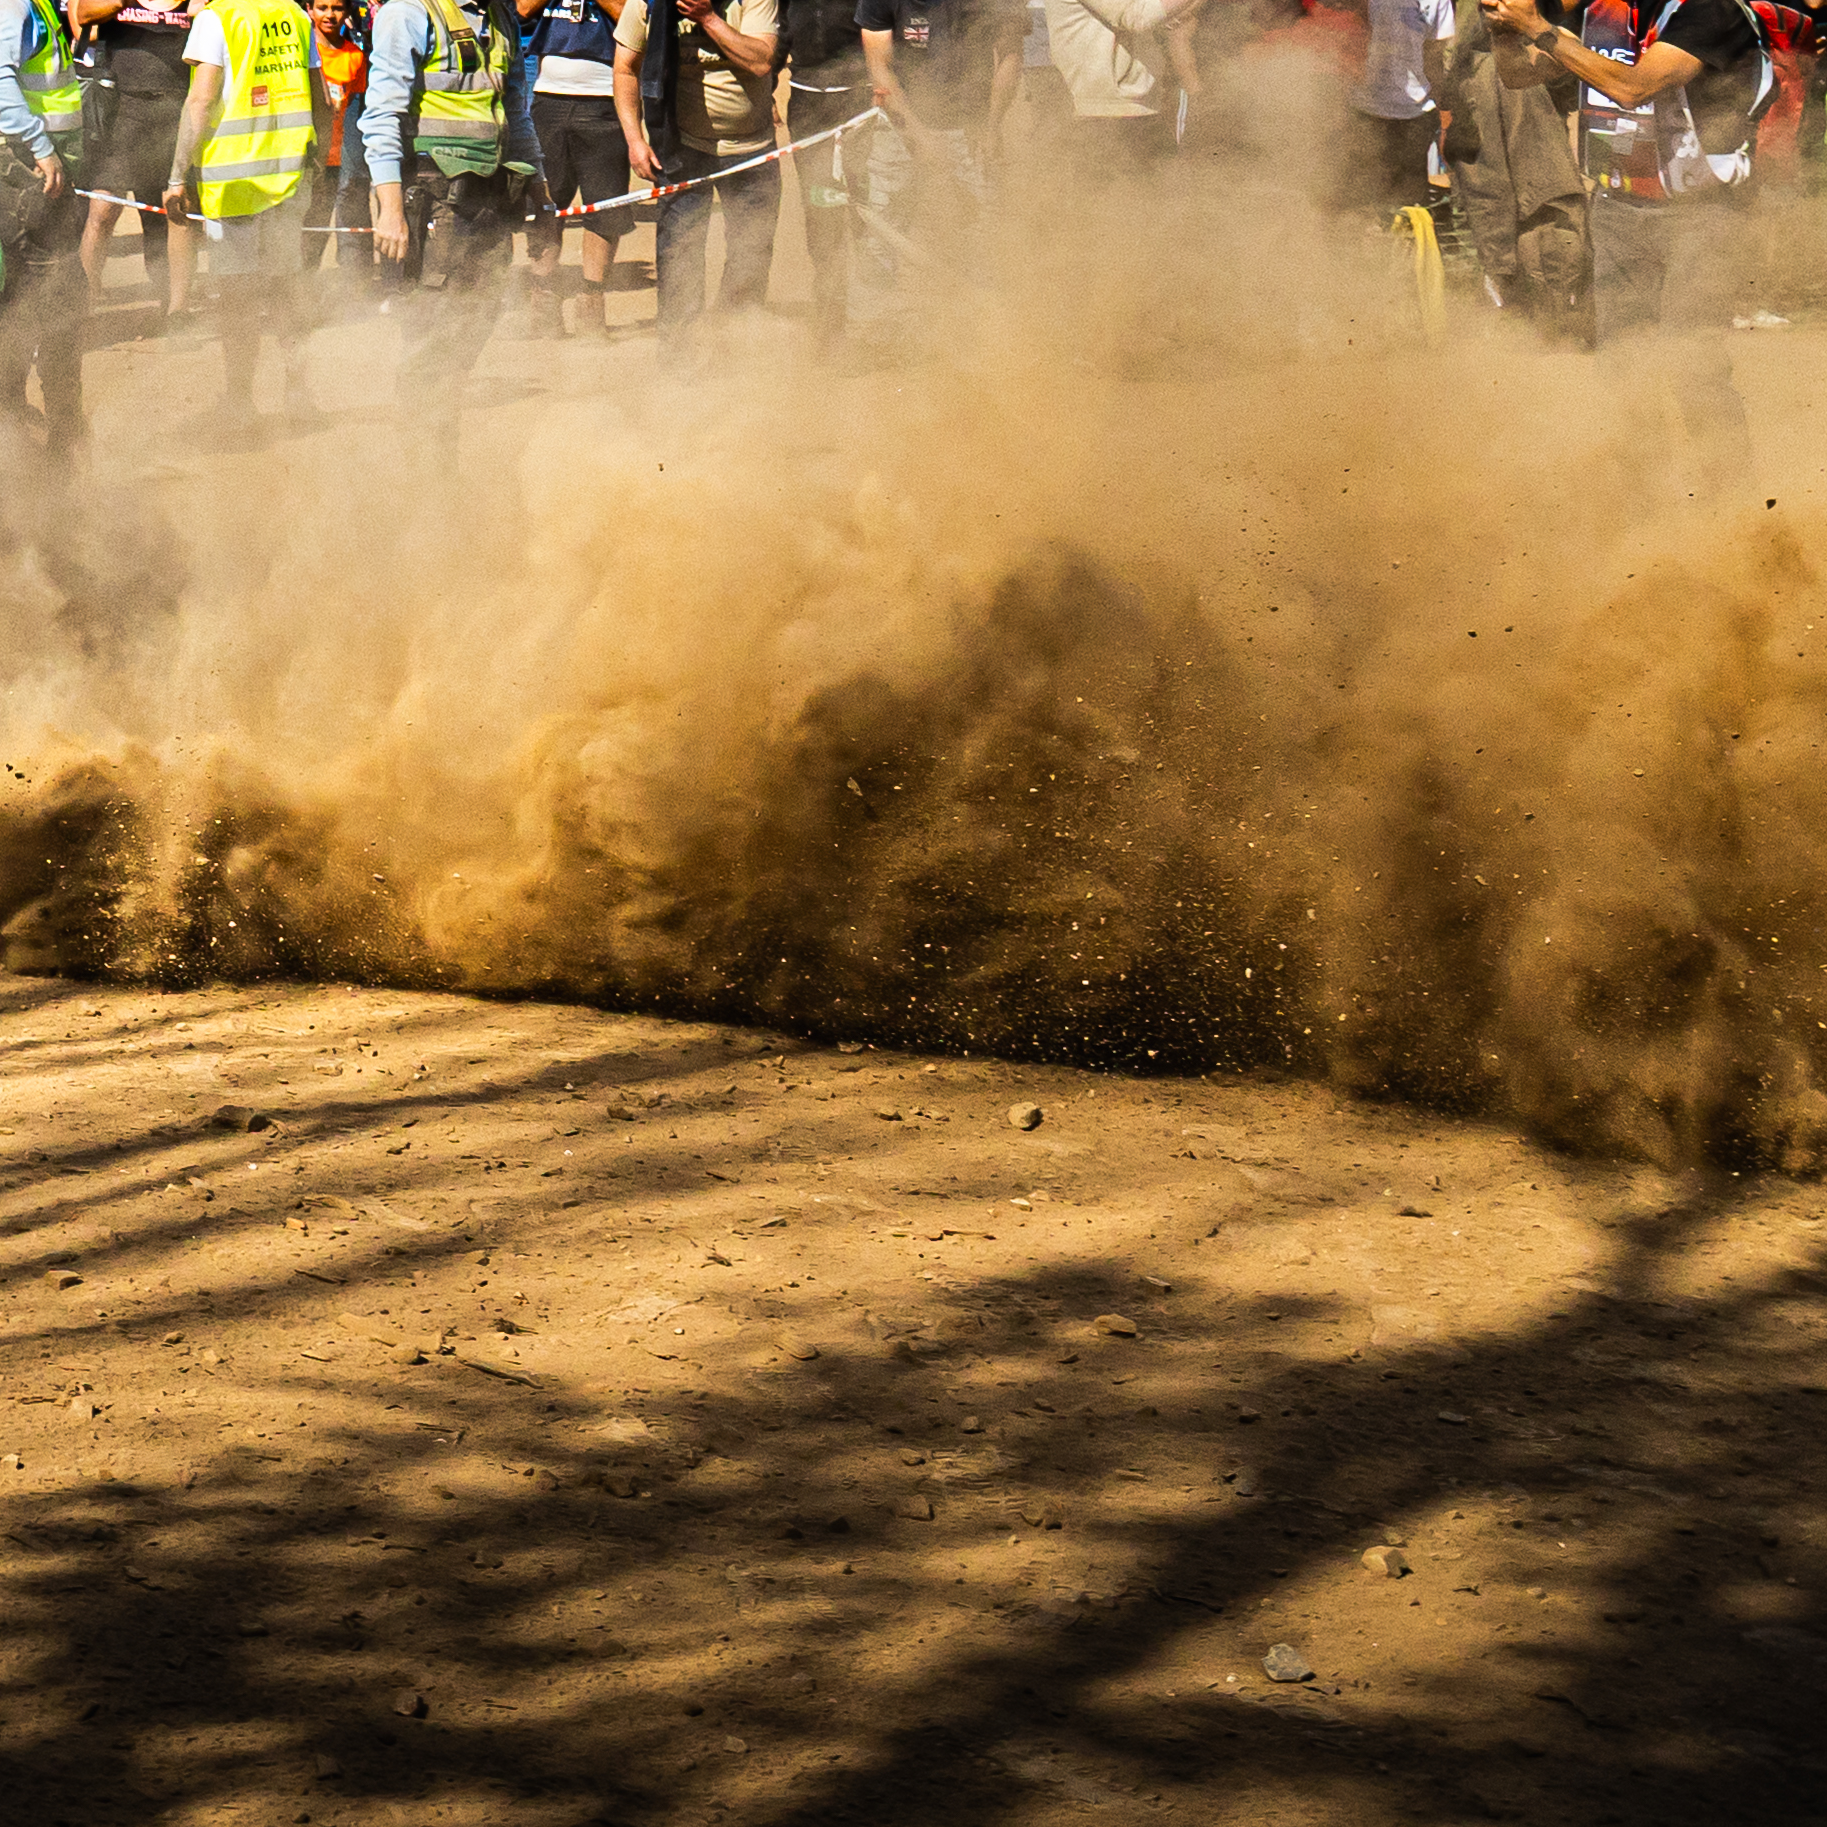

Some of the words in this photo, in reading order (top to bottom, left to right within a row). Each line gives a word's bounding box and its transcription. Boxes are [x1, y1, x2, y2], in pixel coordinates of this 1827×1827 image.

[262, 21, 292, 38] 110
[259, 42, 300, 58] SAFETY
[254, 60, 308, 75] MARSHAL
